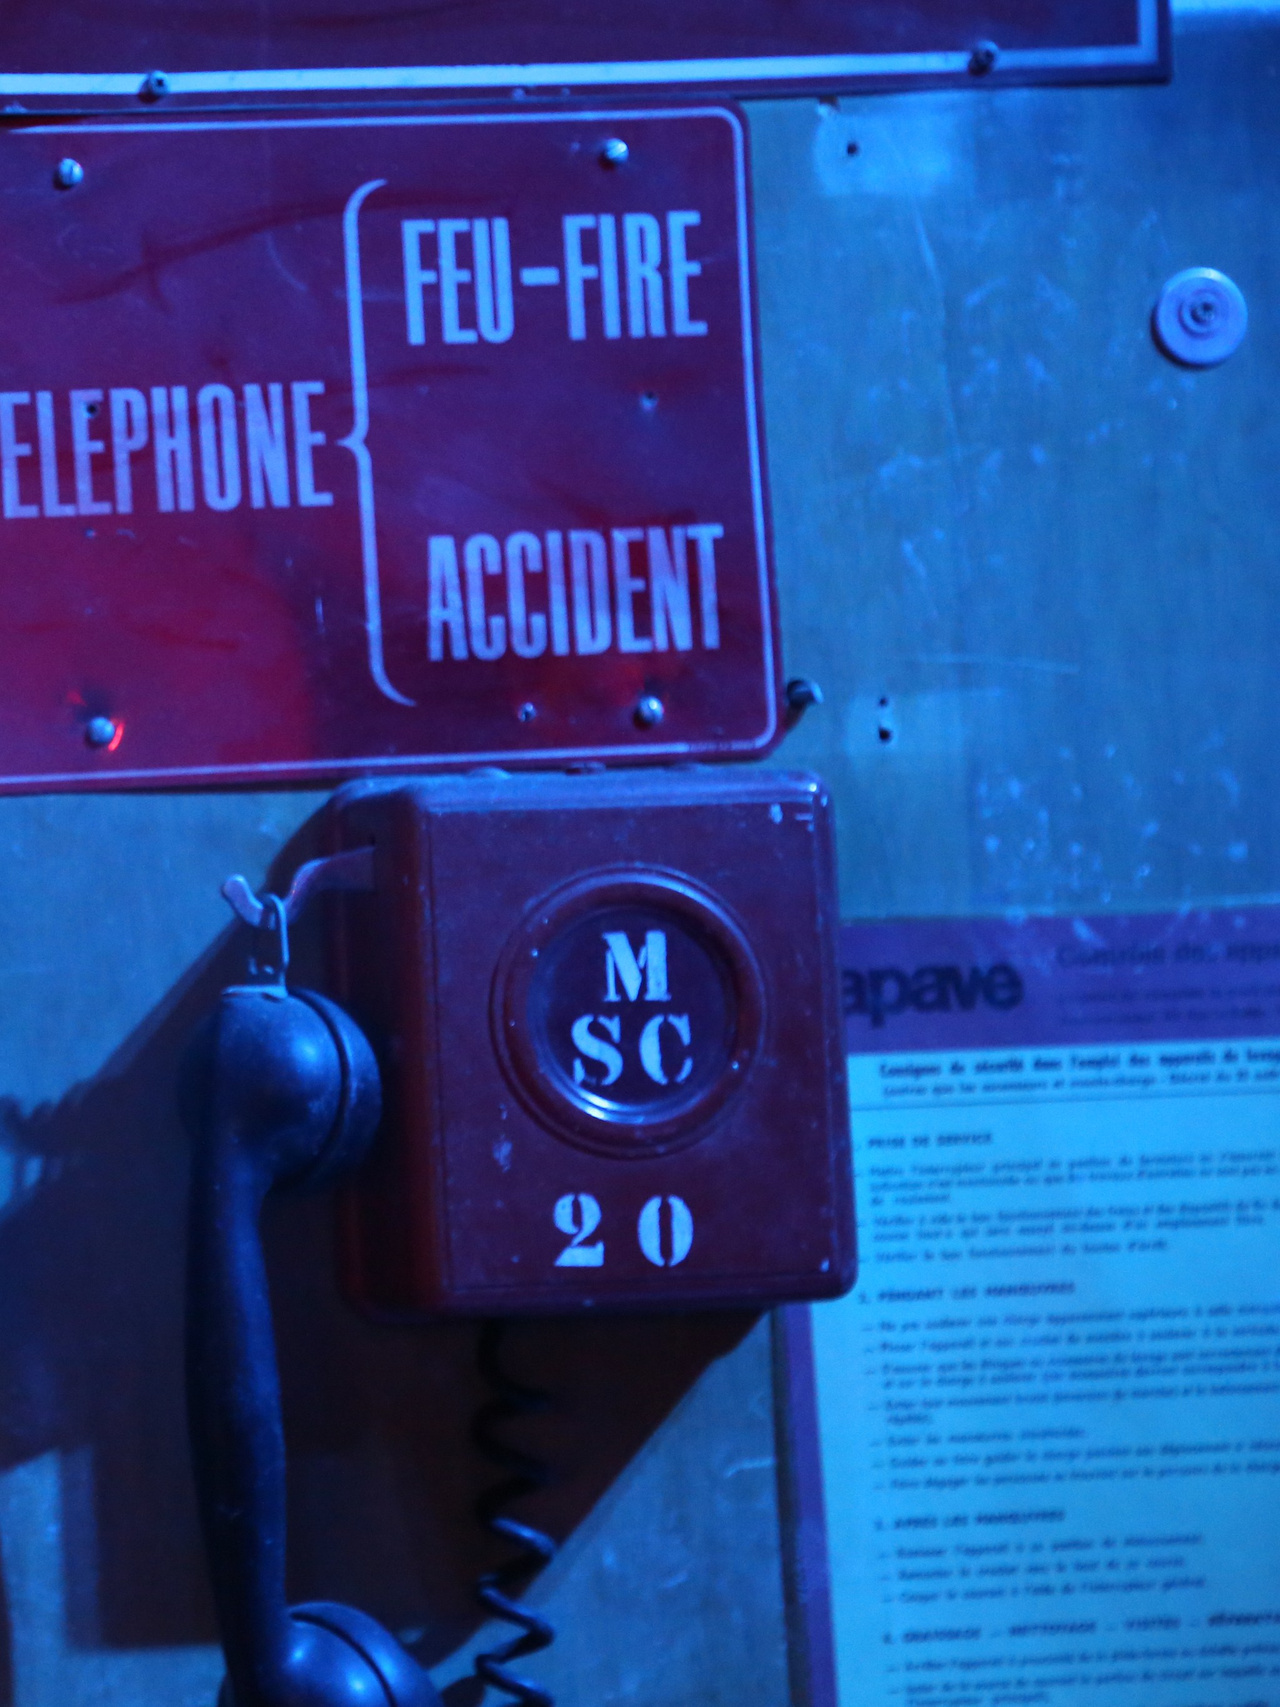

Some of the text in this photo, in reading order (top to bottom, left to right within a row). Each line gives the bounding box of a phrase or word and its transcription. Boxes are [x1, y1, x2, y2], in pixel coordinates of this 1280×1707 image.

[401, 210, 708, 346] FEU-FIRE
[426, 523, 724, 662] ACCIDENT
[602, 929, 671, 1002] M
[841, 960, 1024, 1029] apave
[553, 1193, 694, 1267] 20
